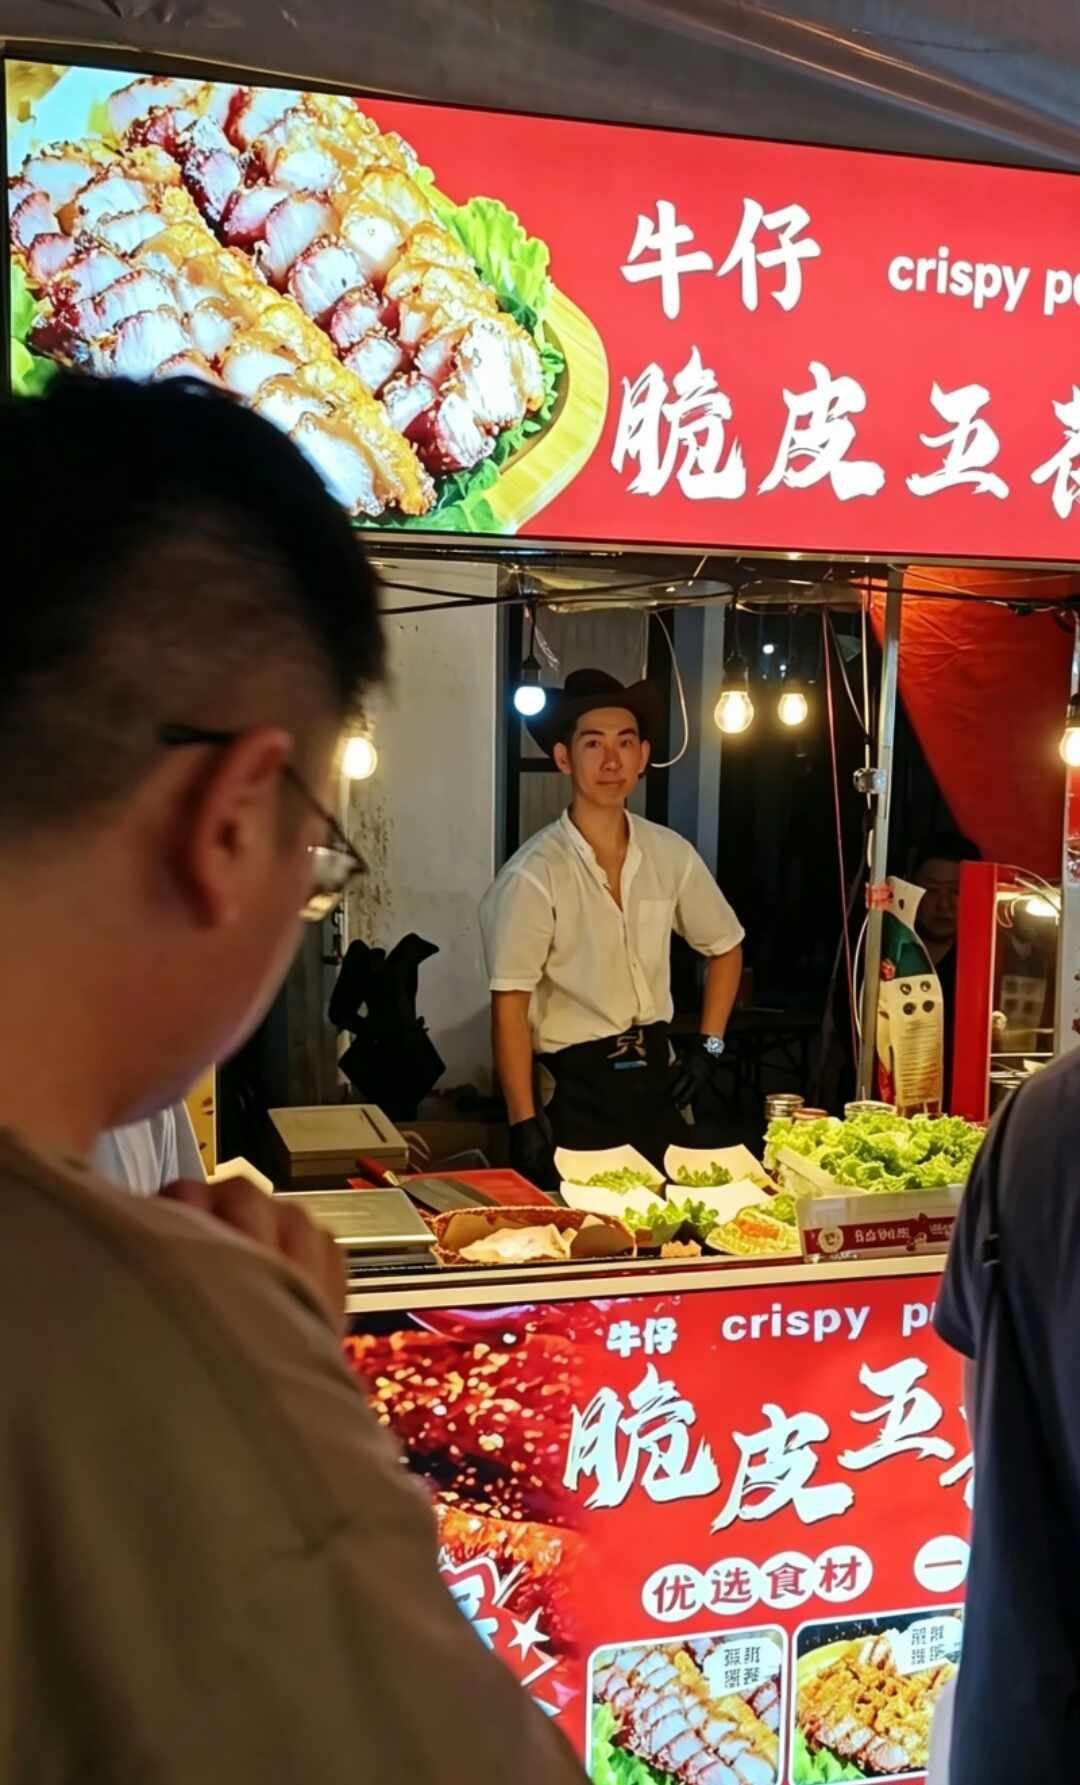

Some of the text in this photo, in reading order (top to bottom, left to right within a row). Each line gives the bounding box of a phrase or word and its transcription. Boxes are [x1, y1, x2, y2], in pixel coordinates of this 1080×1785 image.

[620, 198, 821, 320] 牛仔
[887, 246, 1030, 312] crispy
[606, 1317, 679, 1358] 牛仔
[721, 1302, 936, 1342] crispy p
[562, 1357, 976, 1535] 脆皮五
[652, 1555, 863, 1613] 优选食材
